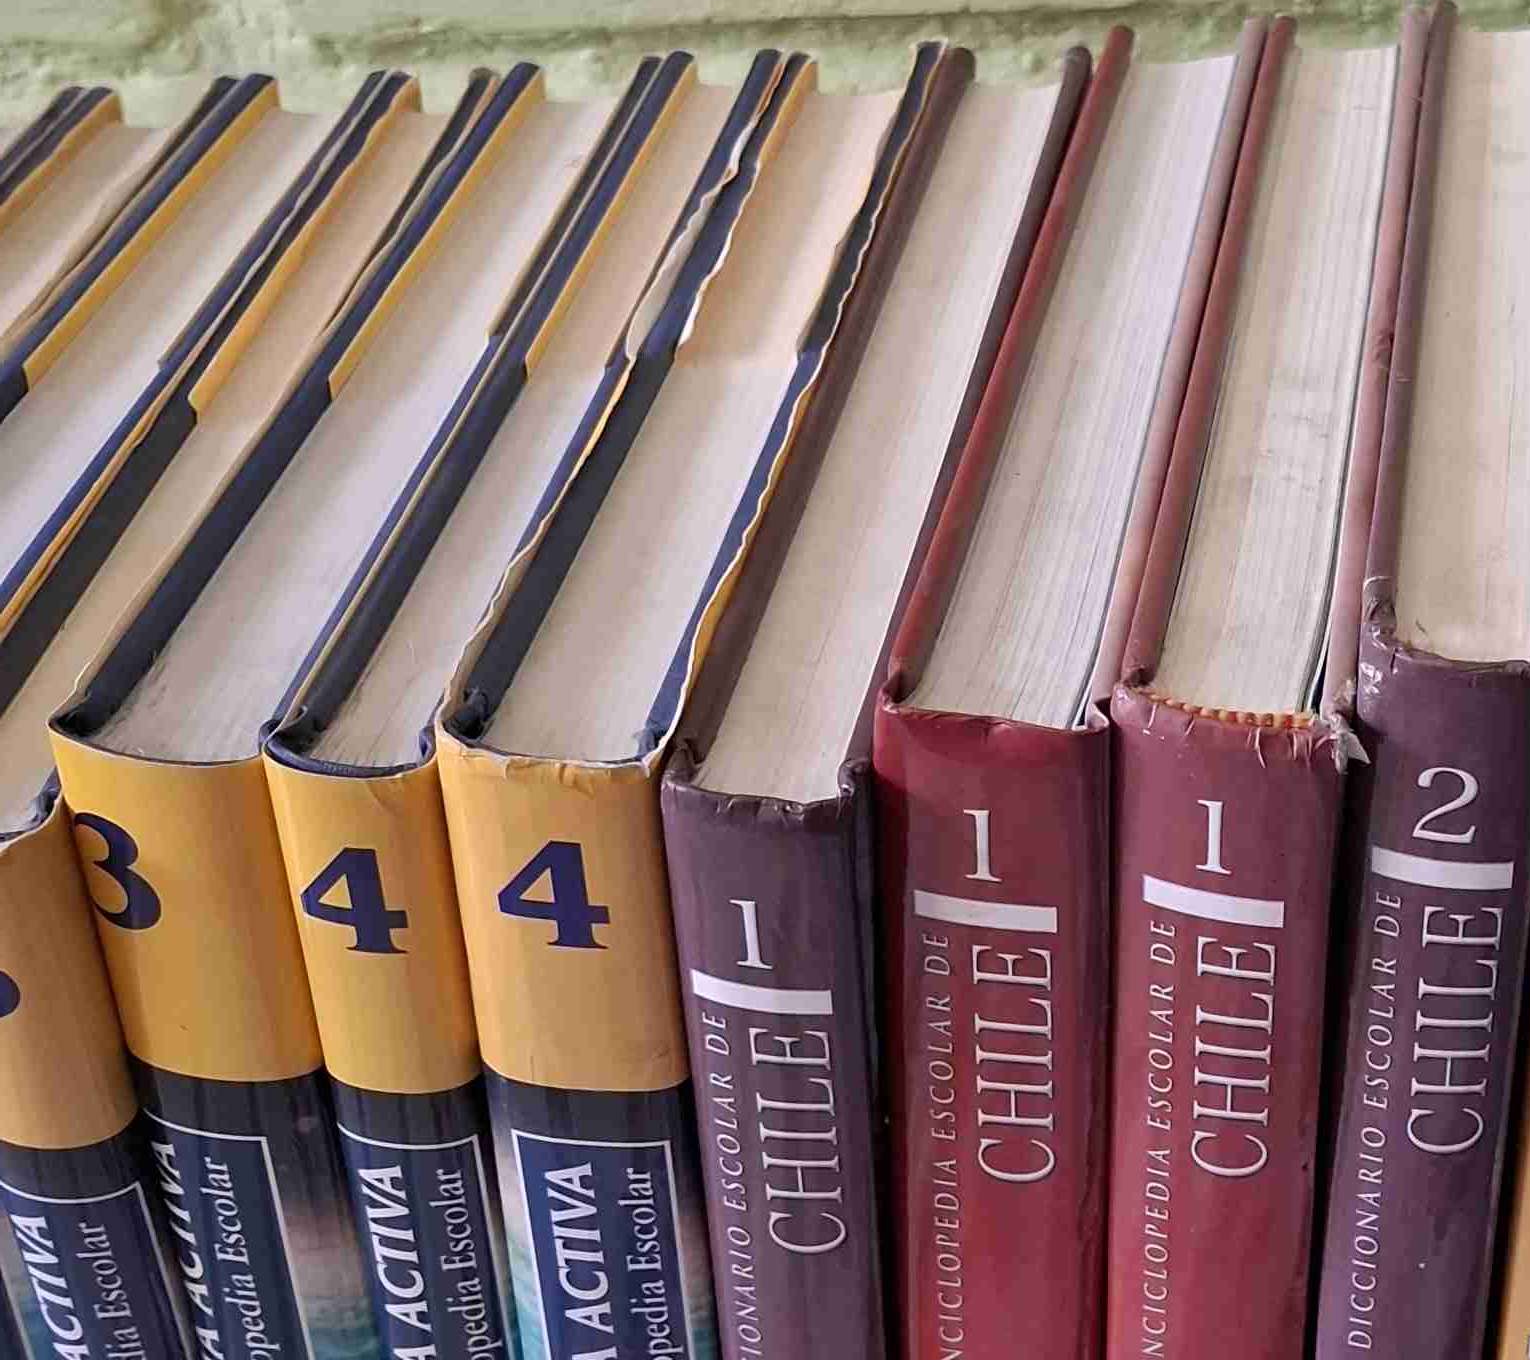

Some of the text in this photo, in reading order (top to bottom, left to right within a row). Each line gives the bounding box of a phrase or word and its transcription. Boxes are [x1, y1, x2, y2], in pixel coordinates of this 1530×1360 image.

[963, 808, 1002, 882] 1
[1197, 799, 1231, 875] 1
[1412, 767, 1478, 844] 2
[74, 812, 162, 931] 3
[300, 847, 409, 954] 4
[496, 840, 610, 950] 4
[729, 898, 773, 971] 1
[923, 933, 951, 978] DE
[1150, 920, 1176, 966] DE
[702, 1011, 731, 1057] DE
[923, 990, 956, 1141] ESCOLAR
[973, 943, 1055, 1183] CHILE
[1148, 981, 1175, 1132] ESCOLAR
[1191, 935, 1276, 1177] CHILE
[1407, 905, 1503, 1155] CHILE
[710, 1074, 748, 1209] ESCOLAR
[749, 1026, 847, 1255] CHILE
[1347, 890, 1403, 1351] DICCIONARIO ESCOLAR DE
[204, 1156, 250, 1264] Escolar
[358, 1165, 433, 1332] ACTIVA
[429, 1168, 478, 1272] Escolar
[544, 1162, 616, 1334] ACTIVA
[617, 1167, 662, 1272] Escolar
[76, 1222, 130, 1320] Escolar
